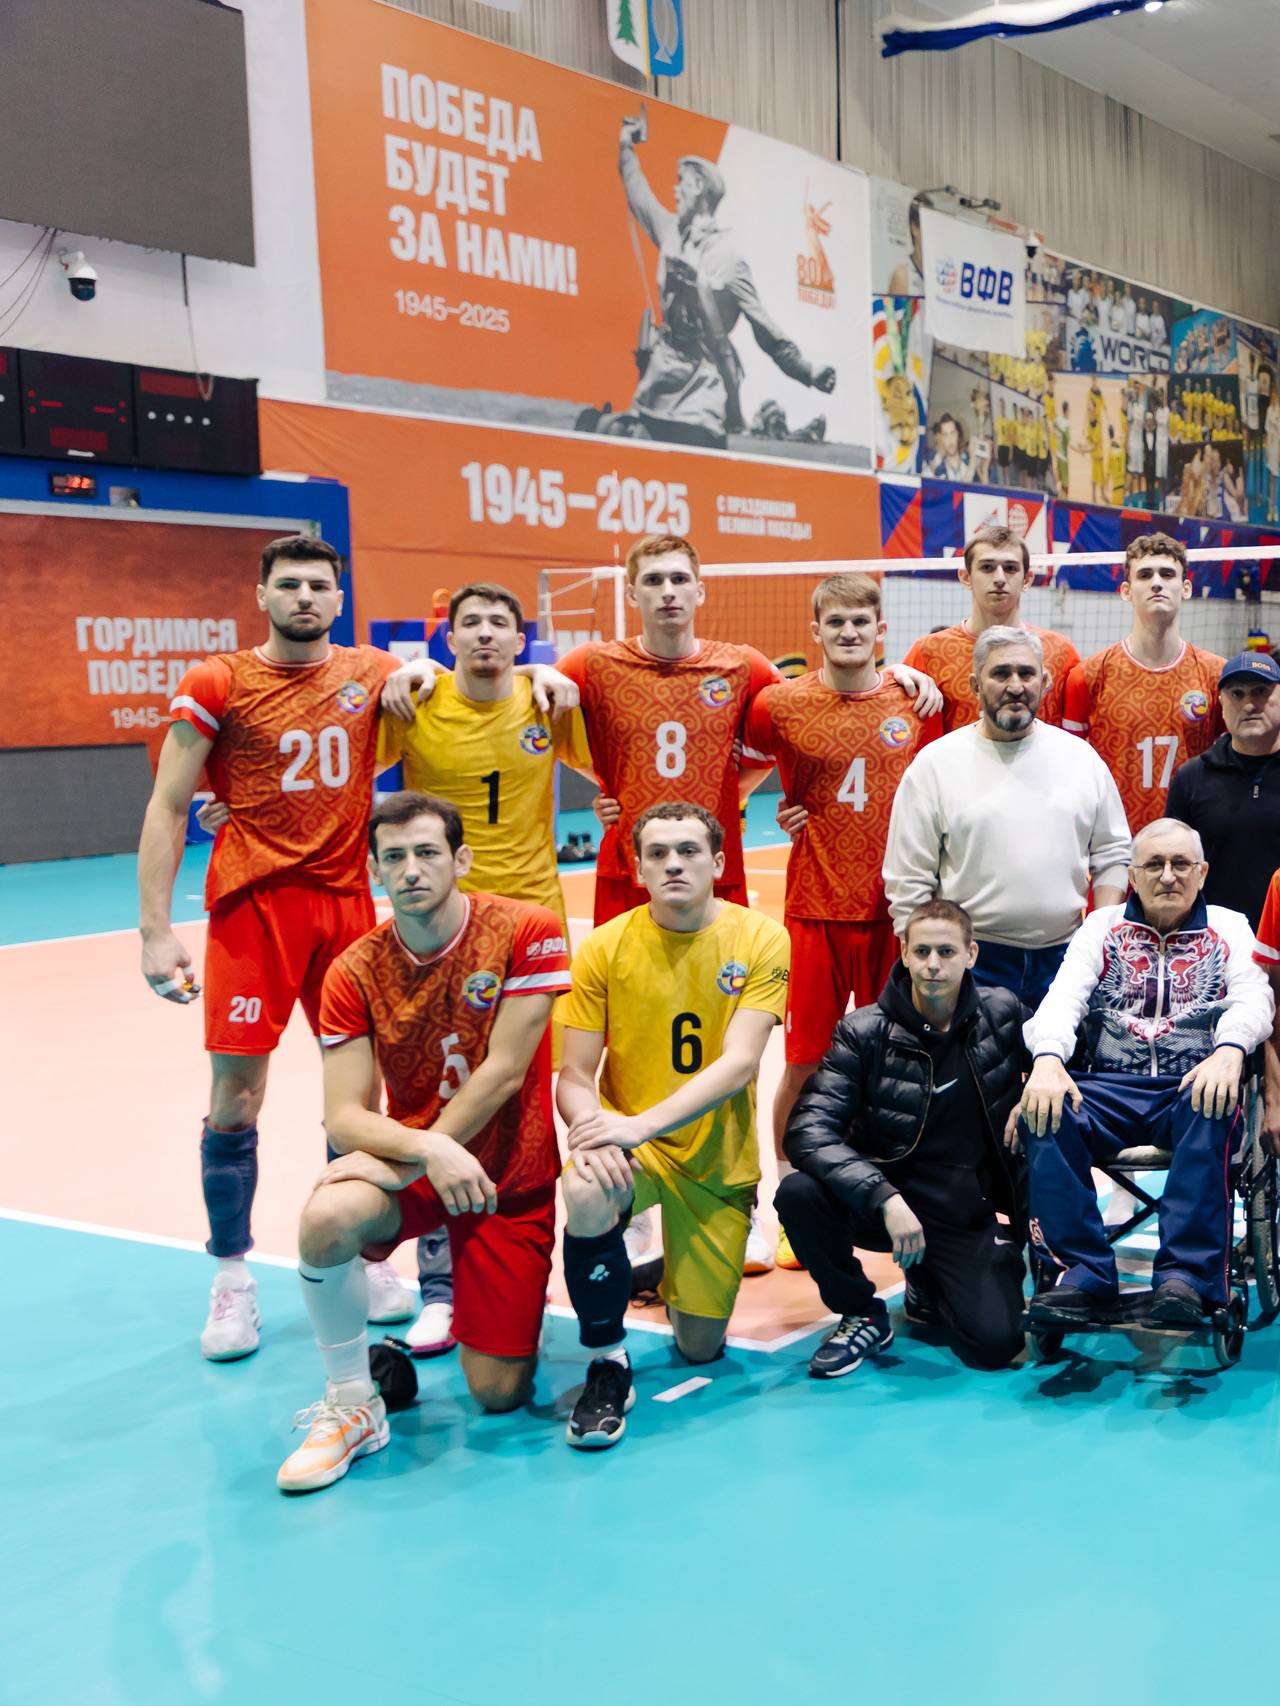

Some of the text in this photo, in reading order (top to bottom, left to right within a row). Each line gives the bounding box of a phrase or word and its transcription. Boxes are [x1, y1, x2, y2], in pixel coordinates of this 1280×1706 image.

[381, 63, 542, 162] ПОБЕДА
[384, 134, 509, 216] БУДЕТ
[388, 205, 579, 296] ЗА НАМИ!
[960, 262, 1013, 306] ВФВ
[76, 616, 238, 657] ГОРДИМСЯ
[87, 659, 202, 699] ПОБЕД
[279, 726, 351, 793] 20
[655, 721, 688, 779] 8
[1136, 735, 1179, 789] 17
[481, 770, 501, 824] 1
[837, 757, 869, 812] 4
[228, 995, 262, 1023] 20
[439, 1033, 470, 1100] 5
[671, 1012, 703, 1075] 6
